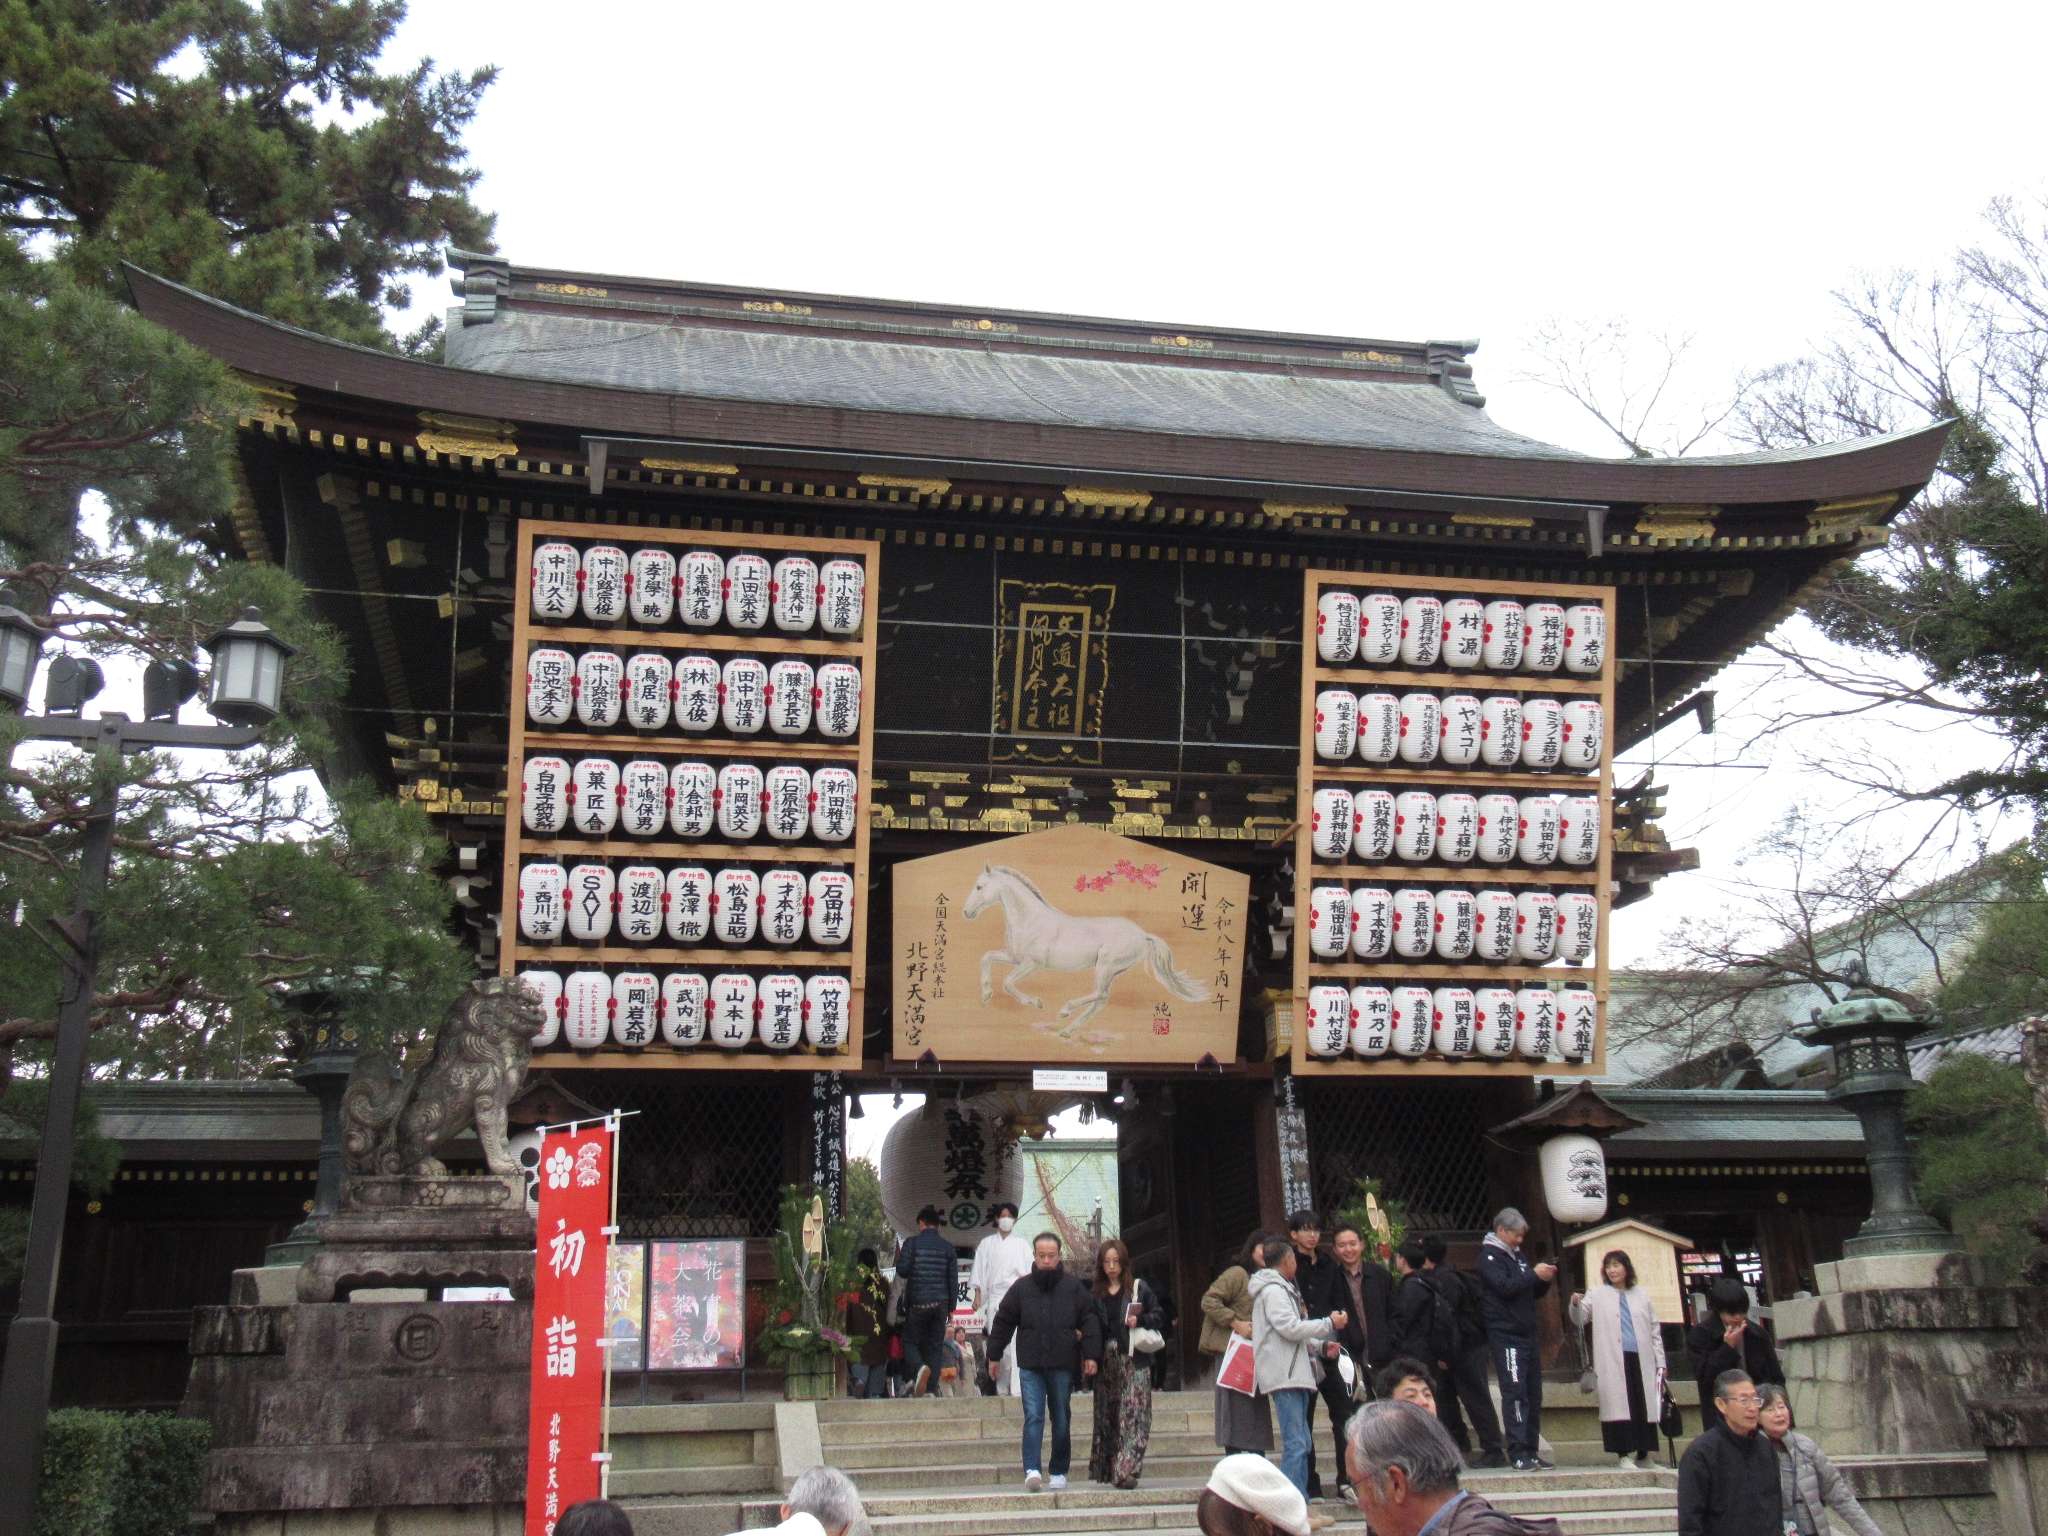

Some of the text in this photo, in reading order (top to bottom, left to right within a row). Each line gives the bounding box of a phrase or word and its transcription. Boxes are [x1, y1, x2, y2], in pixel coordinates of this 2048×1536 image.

[546, 554, 566, 613] 中川久公
[594, 557, 614, 616] 中小路宗俊
[1584, 735, 1596, 761] もり
[583, 876, 601, 931] SAY
[727, 883, 749, 939] 松島正昭
[773, 882, 795, 939] 才本和範
[821, 885, 843, 939] 石田耕三
[1181, 871, 1210, 932] 開運
[1211, 897, 1237, 1012] 令和八年丙午
[724, 988, 745, 1040] 山本山
[904, 941, 928, 1047] 北野天満宮
[1368, 1001, 1387, 1049] 和乃匠
[545, 1217, 586, 1377] 初詣
